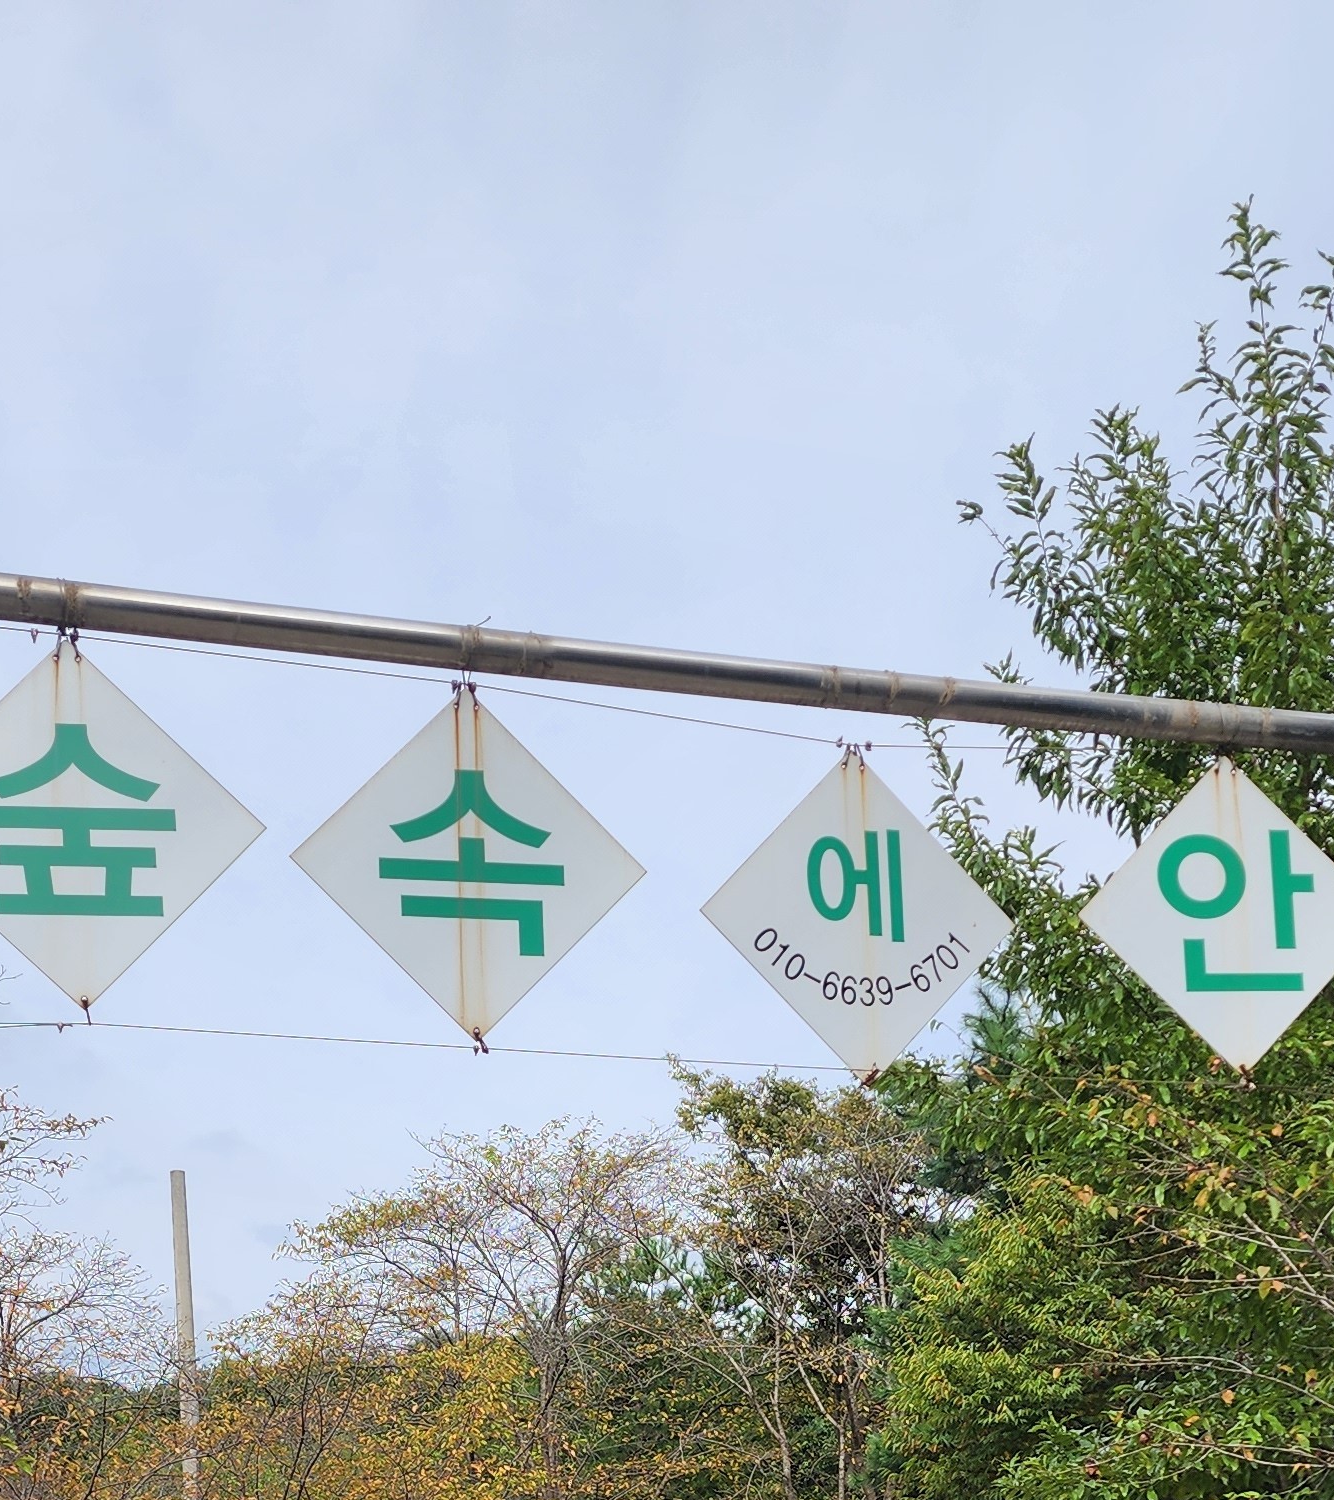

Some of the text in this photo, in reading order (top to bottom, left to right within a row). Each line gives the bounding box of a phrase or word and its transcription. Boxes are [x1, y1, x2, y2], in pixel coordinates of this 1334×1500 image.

[378, 769, 565, 957] 속
[806, 828, 906, 943] 에
[1156, 828, 1315, 992] 안
[753, 927, 972, 1007] 010-6639-6701
